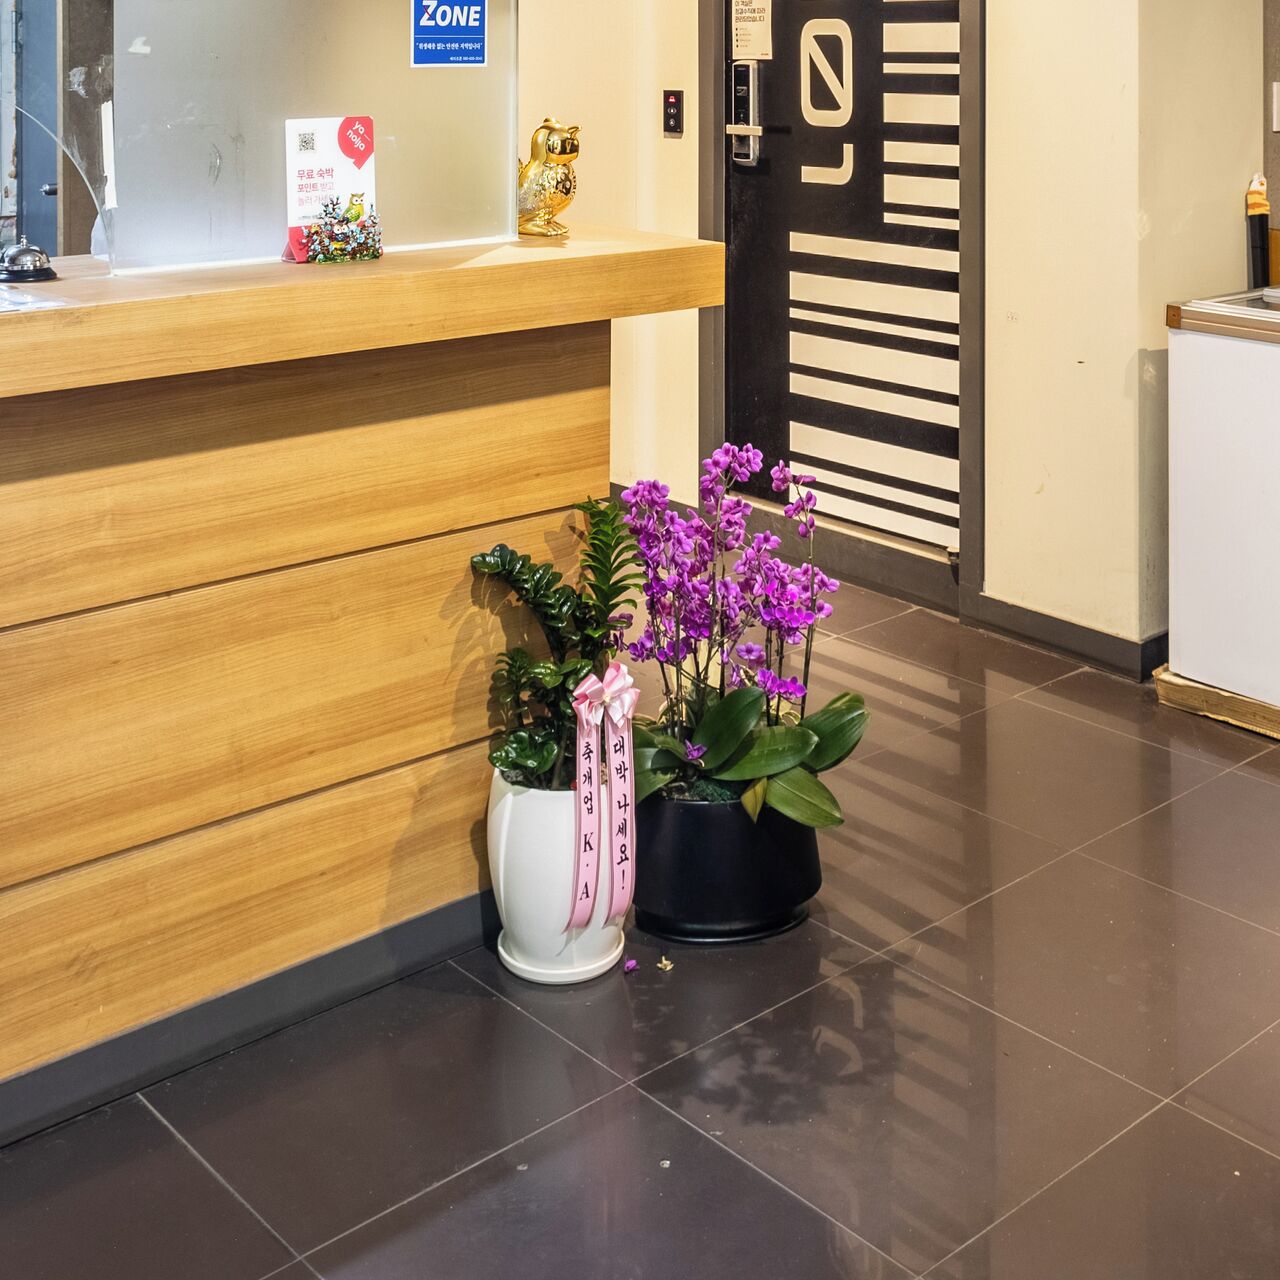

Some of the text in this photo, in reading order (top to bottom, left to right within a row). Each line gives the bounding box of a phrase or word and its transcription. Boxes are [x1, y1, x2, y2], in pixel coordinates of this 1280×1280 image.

[420, 0, 481, 27] ZONE
[297, 167, 334, 180] 무료 숙박
[297, 182, 319, 193] 포인트
[581, 741, 594, 815] 축개업
[613, 735, 630, 890] 대박 나세요!
